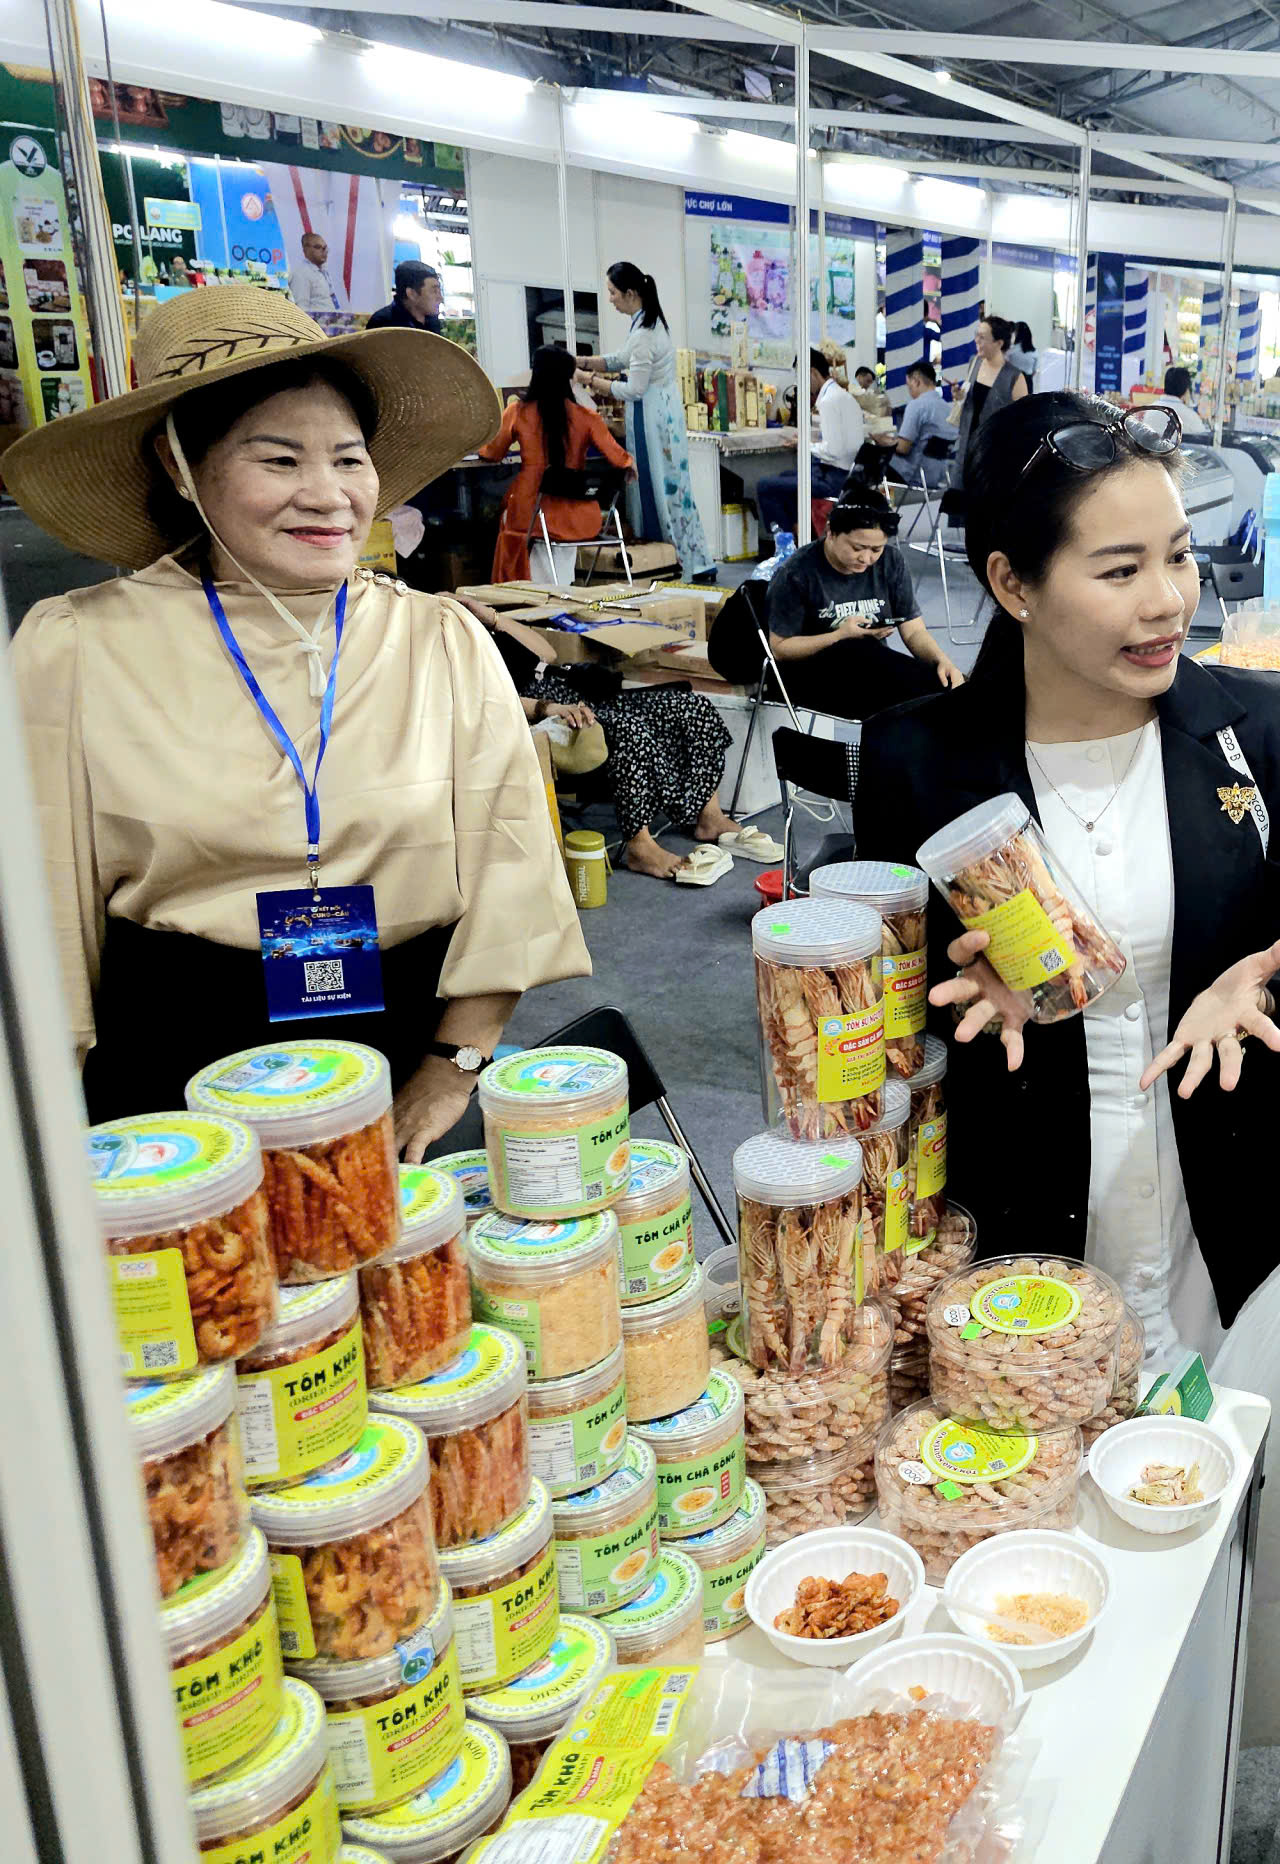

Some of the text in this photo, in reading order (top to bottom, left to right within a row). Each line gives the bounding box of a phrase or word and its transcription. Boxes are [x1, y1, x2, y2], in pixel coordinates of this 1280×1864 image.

[231, 245, 282, 264] OCOP
[843, 1042, 857, 1051] ĐẶC
[857, 1038, 869, 1047] SẢN
[591, 1129, 612, 1146] TÔM
[635, 1230, 659, 1245] TÔM
[284, 1341, 358, 1397] TÔM KHÔ
[586, 1410, 608, 1429] TÔM
[658, 1449, 736, 1485] TÔM CHÀ BÔNG
[594, 1543, 620, 1558] TÔM
[710, 1574, 733, 1589] TÔM
[502, 1585, 534, 1612] TÔM
[175, 1637, 262, 1703] TÔM KHÔ
[377, 1671, 450, 1732] TÔM KHÔ
[553, 1752, 581, 1786] KHÔ
[274, 1814, 312, 1856] KHÔ
